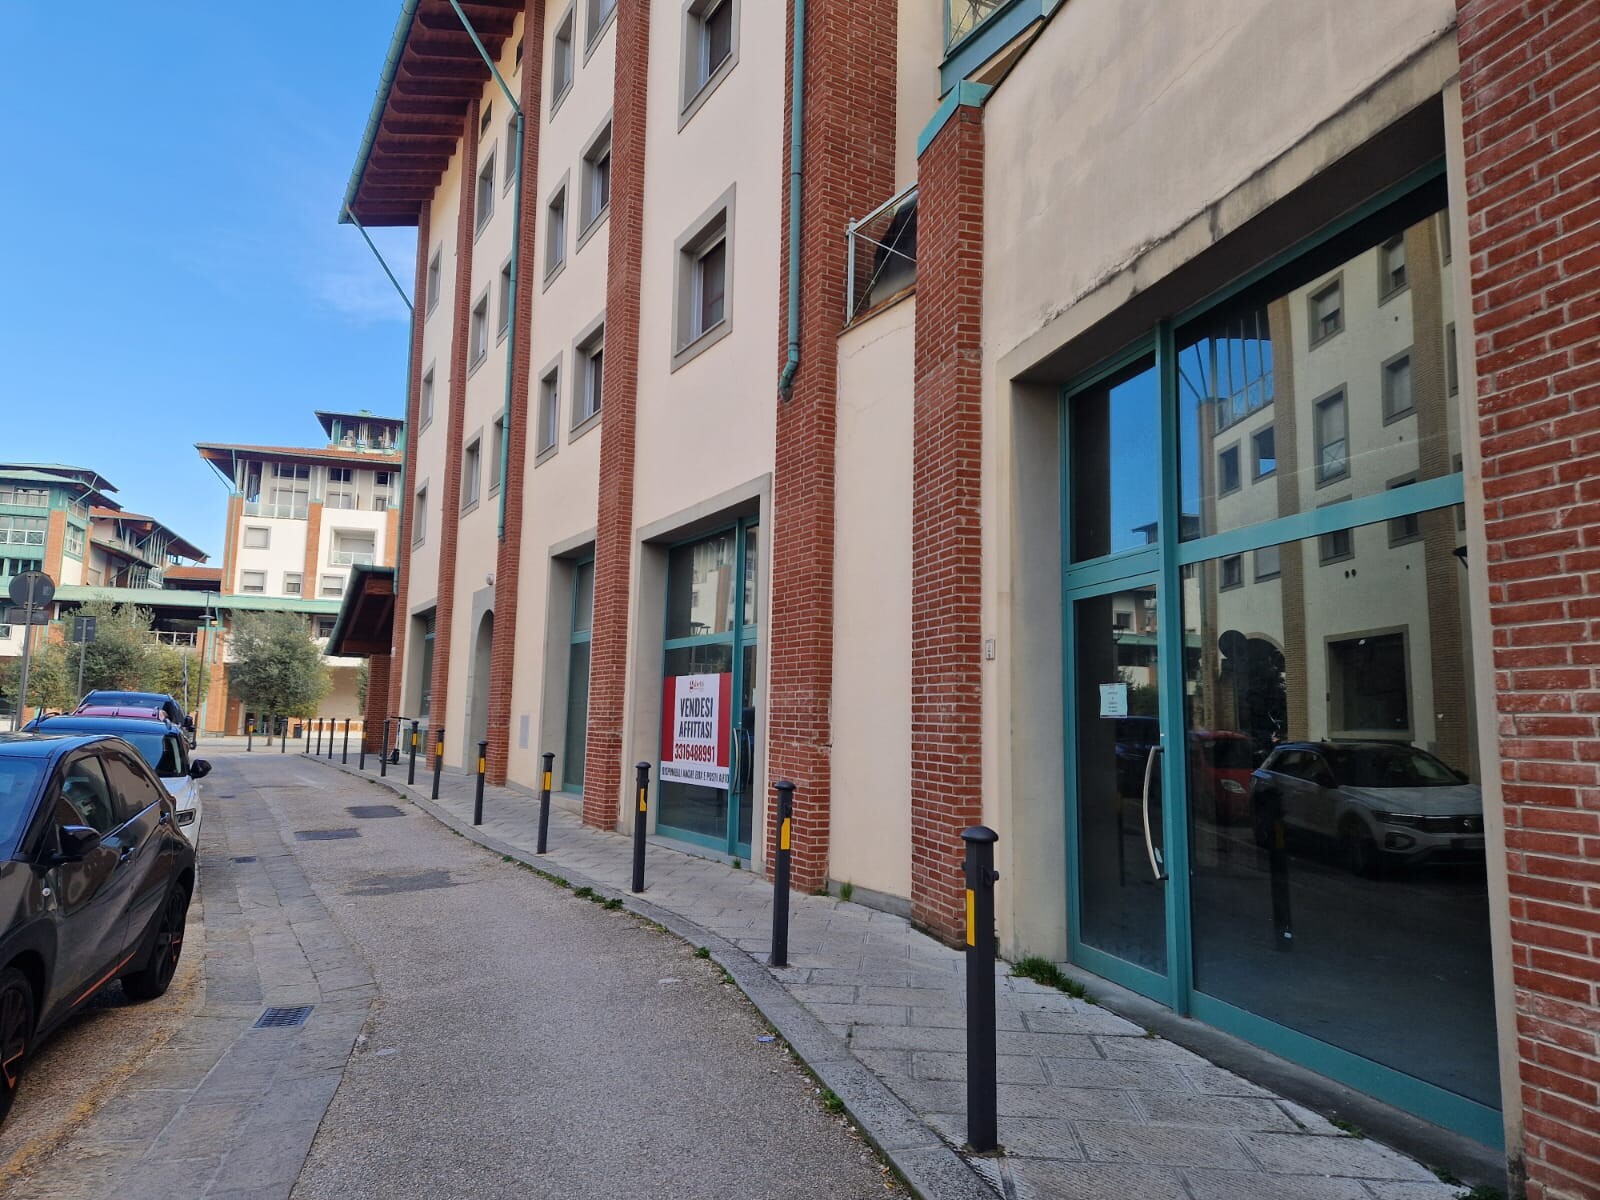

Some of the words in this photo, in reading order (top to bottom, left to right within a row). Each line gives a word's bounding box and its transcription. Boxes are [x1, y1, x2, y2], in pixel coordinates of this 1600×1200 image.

[680, 697, 713, 718] VENDESI
[678, 720, 712, 739] AFFITTASI
[674, 743, 715, 763] 3316488991
